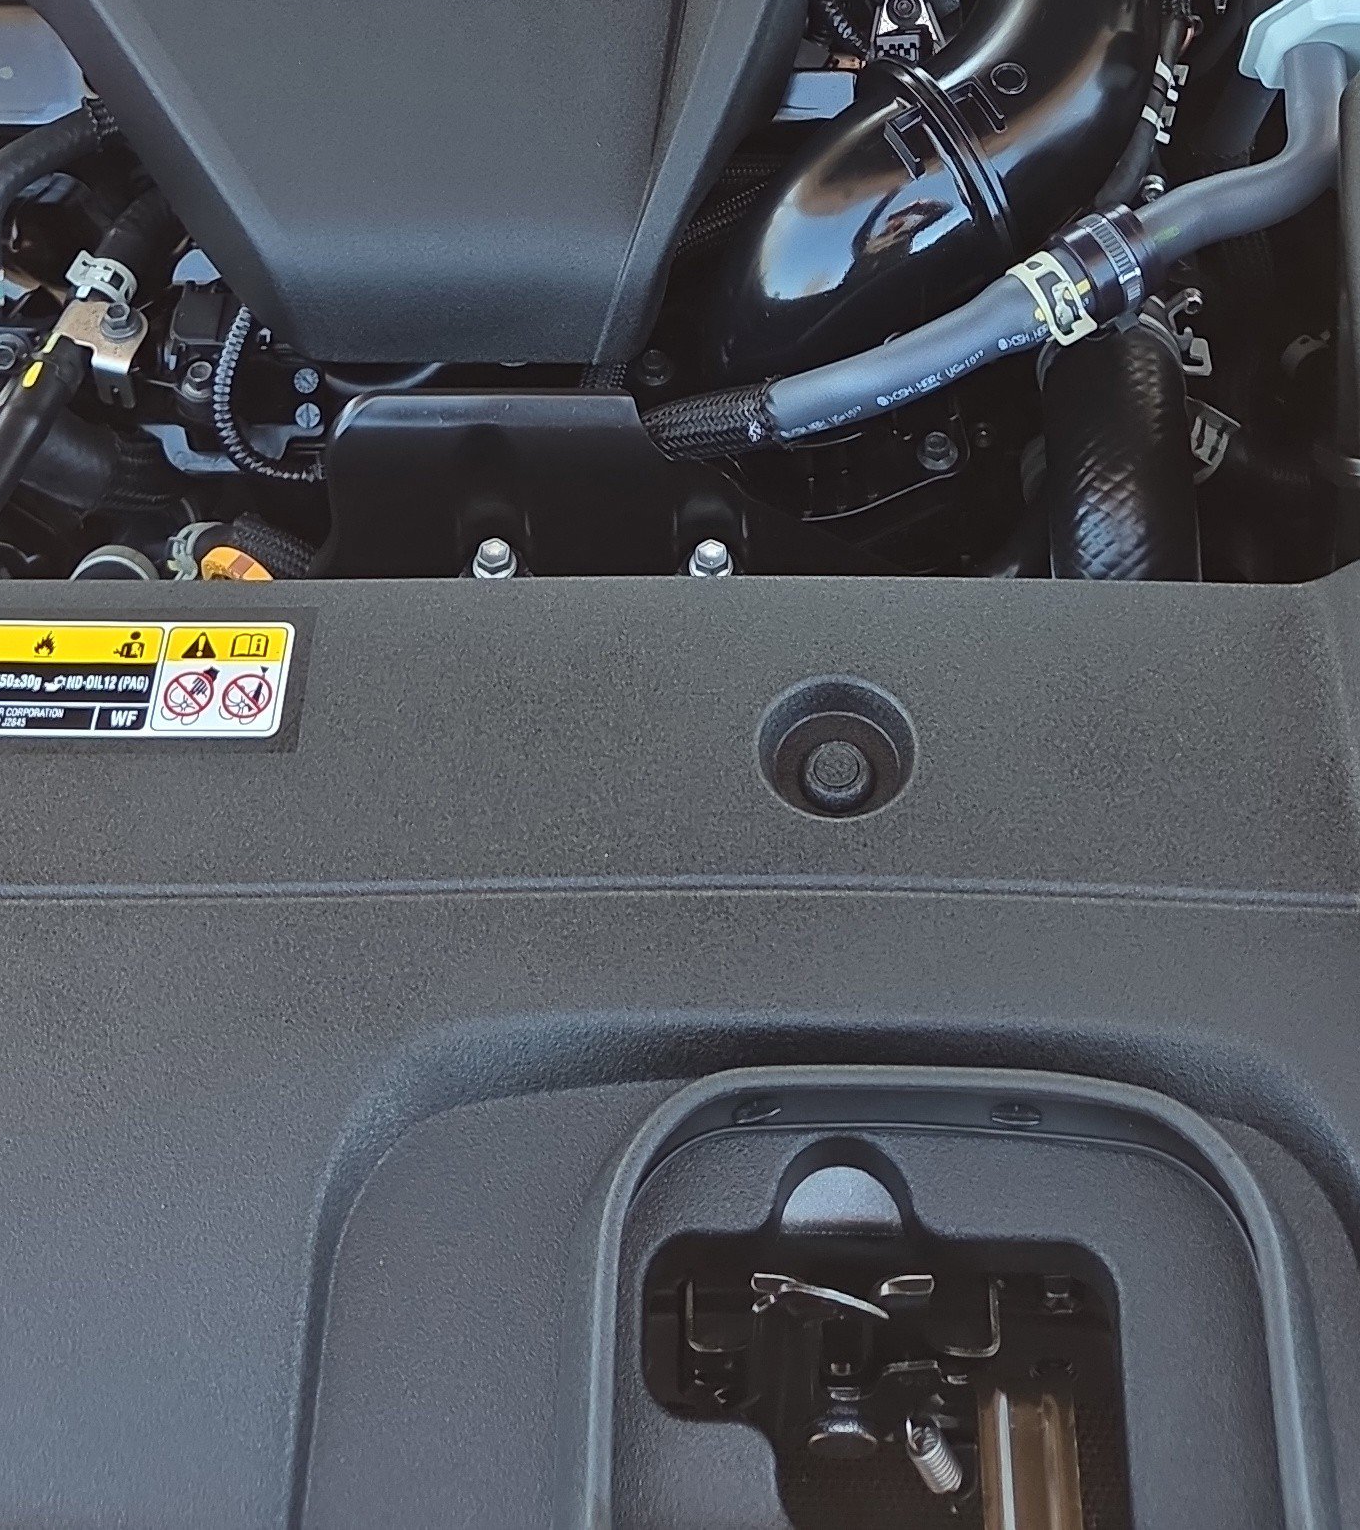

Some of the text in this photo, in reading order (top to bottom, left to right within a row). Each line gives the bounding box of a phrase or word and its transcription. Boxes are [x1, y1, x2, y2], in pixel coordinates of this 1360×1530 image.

[118, 675, 150, 693] (PAG)
[6, 708, 64, 719] CORPORATION
[110, 710, 137, 728] WF
